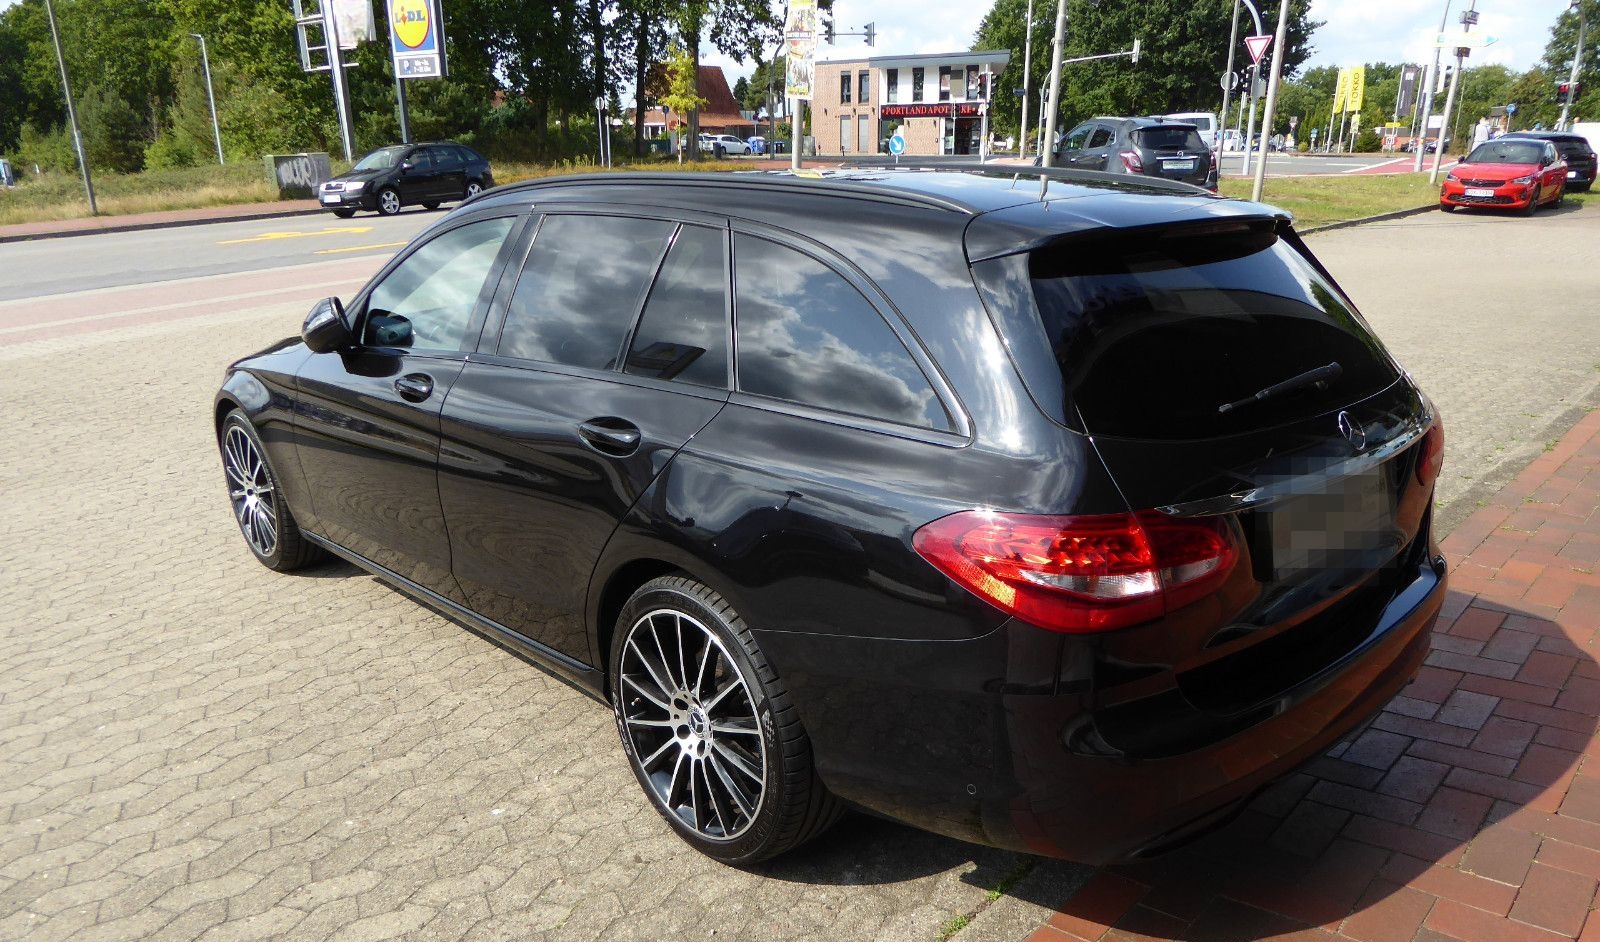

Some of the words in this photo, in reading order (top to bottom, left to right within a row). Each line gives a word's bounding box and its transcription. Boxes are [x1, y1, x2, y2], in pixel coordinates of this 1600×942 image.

[1351, 72, 1360, 104] TOKKO
[885, 105, 927, 115] PORTLAND
[928, 105, 972, 115] APOTKE
